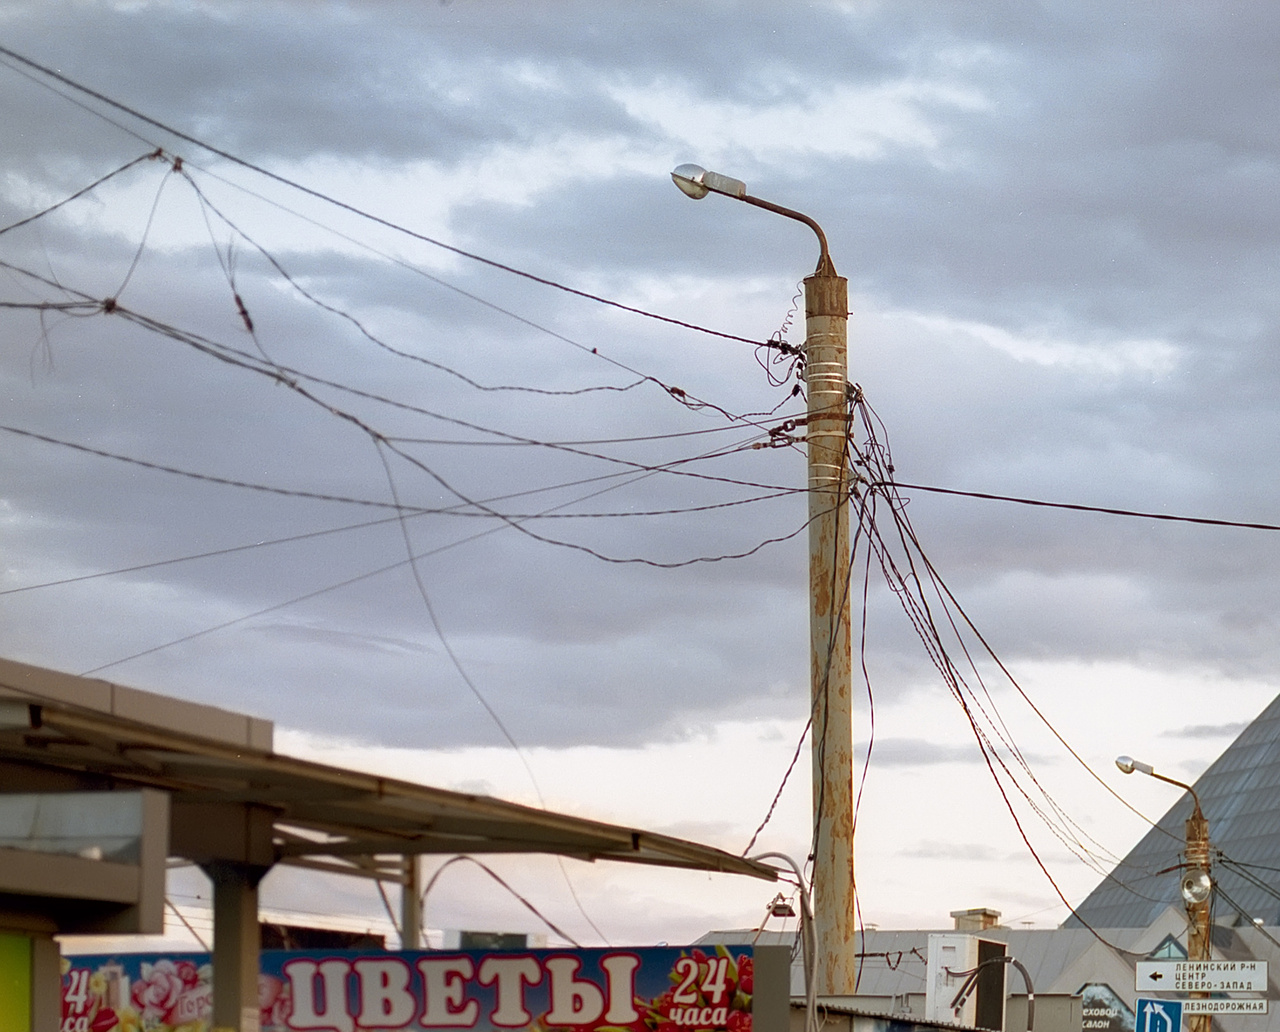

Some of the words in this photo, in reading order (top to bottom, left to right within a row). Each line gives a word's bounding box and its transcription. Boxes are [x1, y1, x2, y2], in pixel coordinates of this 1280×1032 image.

[1175, 963, 1236, 972] ЛЕНИНСКИЙ
[1240, 963, 1256, 971] Р-Н
[675, 957, 727, 1005] 24
[1175, 972, 1207, 981] ЦЕНТР
[1175, 981, 1253, 990] СЕВЕРО-ЗАПАД
[64, 969, 90, 1014] 4
[1082, 1007, 1118, 1017] еховой
[1184, 1002, 1264, 1012] ЛЕЗНОДОРОЖНАЯ
[669, 1003, 728, 1027] часа
[1082, 1020, 1110, 1029] салон
